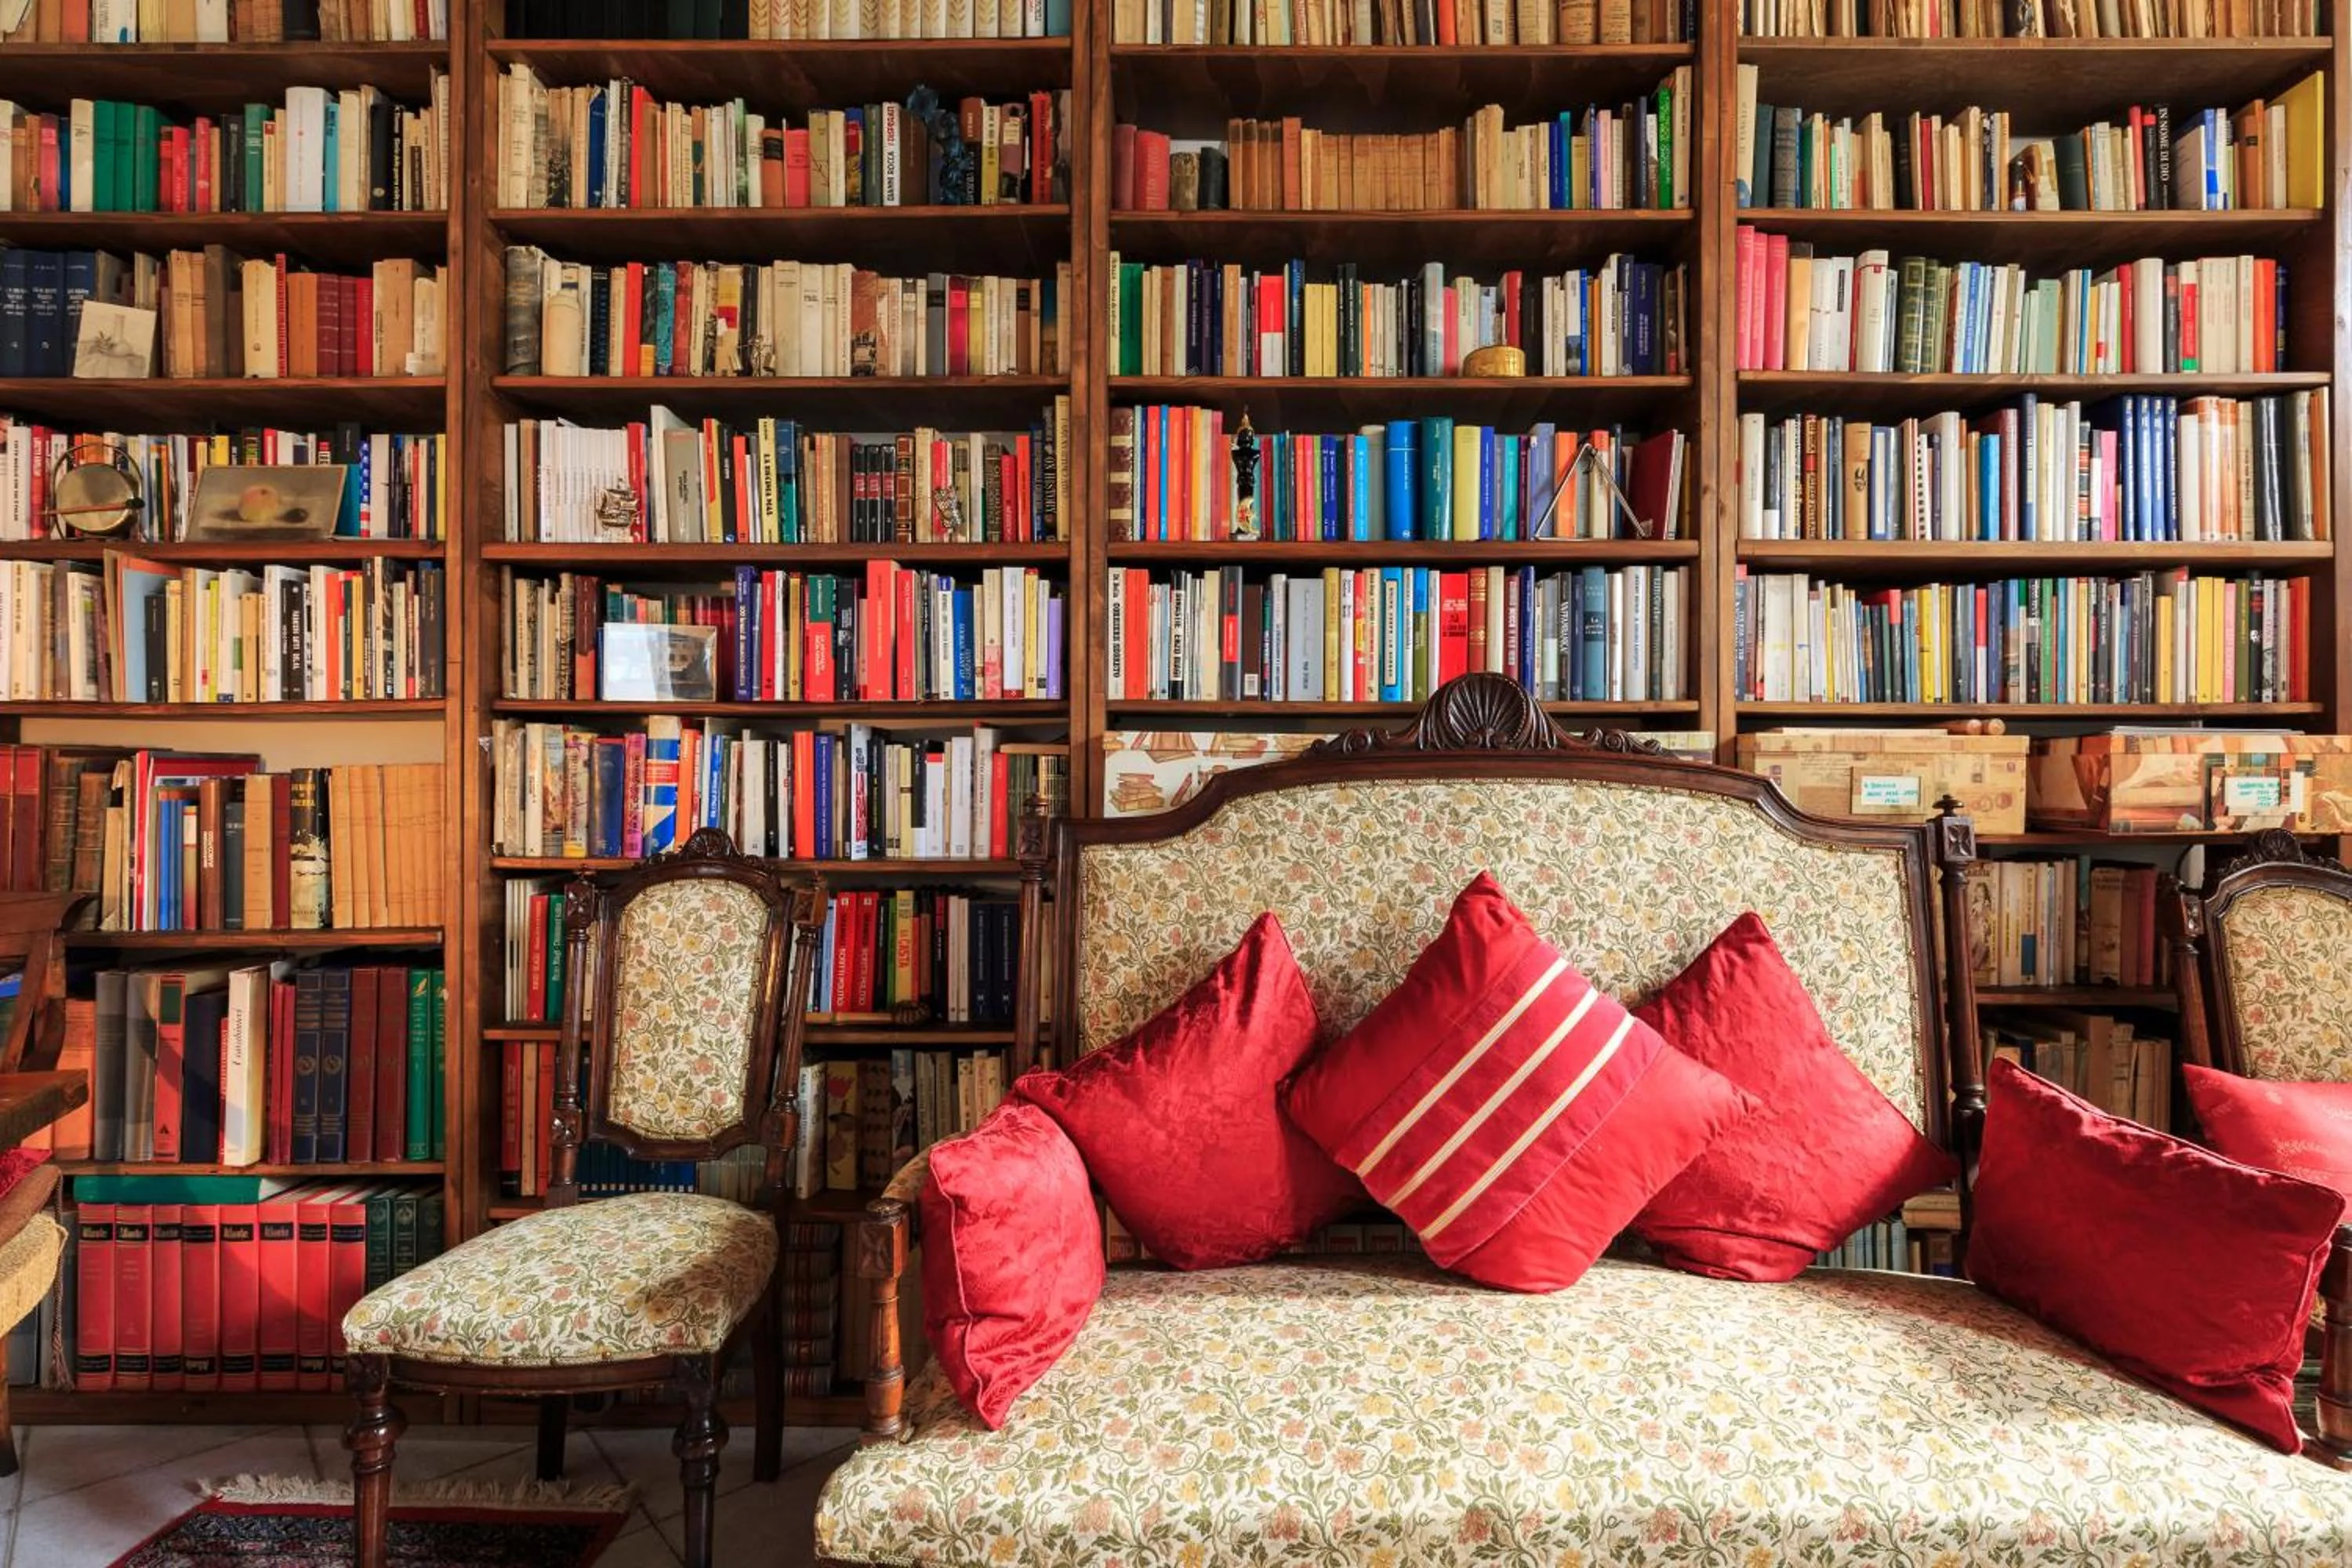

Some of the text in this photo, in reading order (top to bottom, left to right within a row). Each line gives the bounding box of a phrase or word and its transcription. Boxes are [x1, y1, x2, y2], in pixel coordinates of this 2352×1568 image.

[2158, 107, 2169, 181] IN NOME DI DIO
[1044, 456, 1056, 514] ON HISTORY
[898, 938, 910, 969] CASTA
